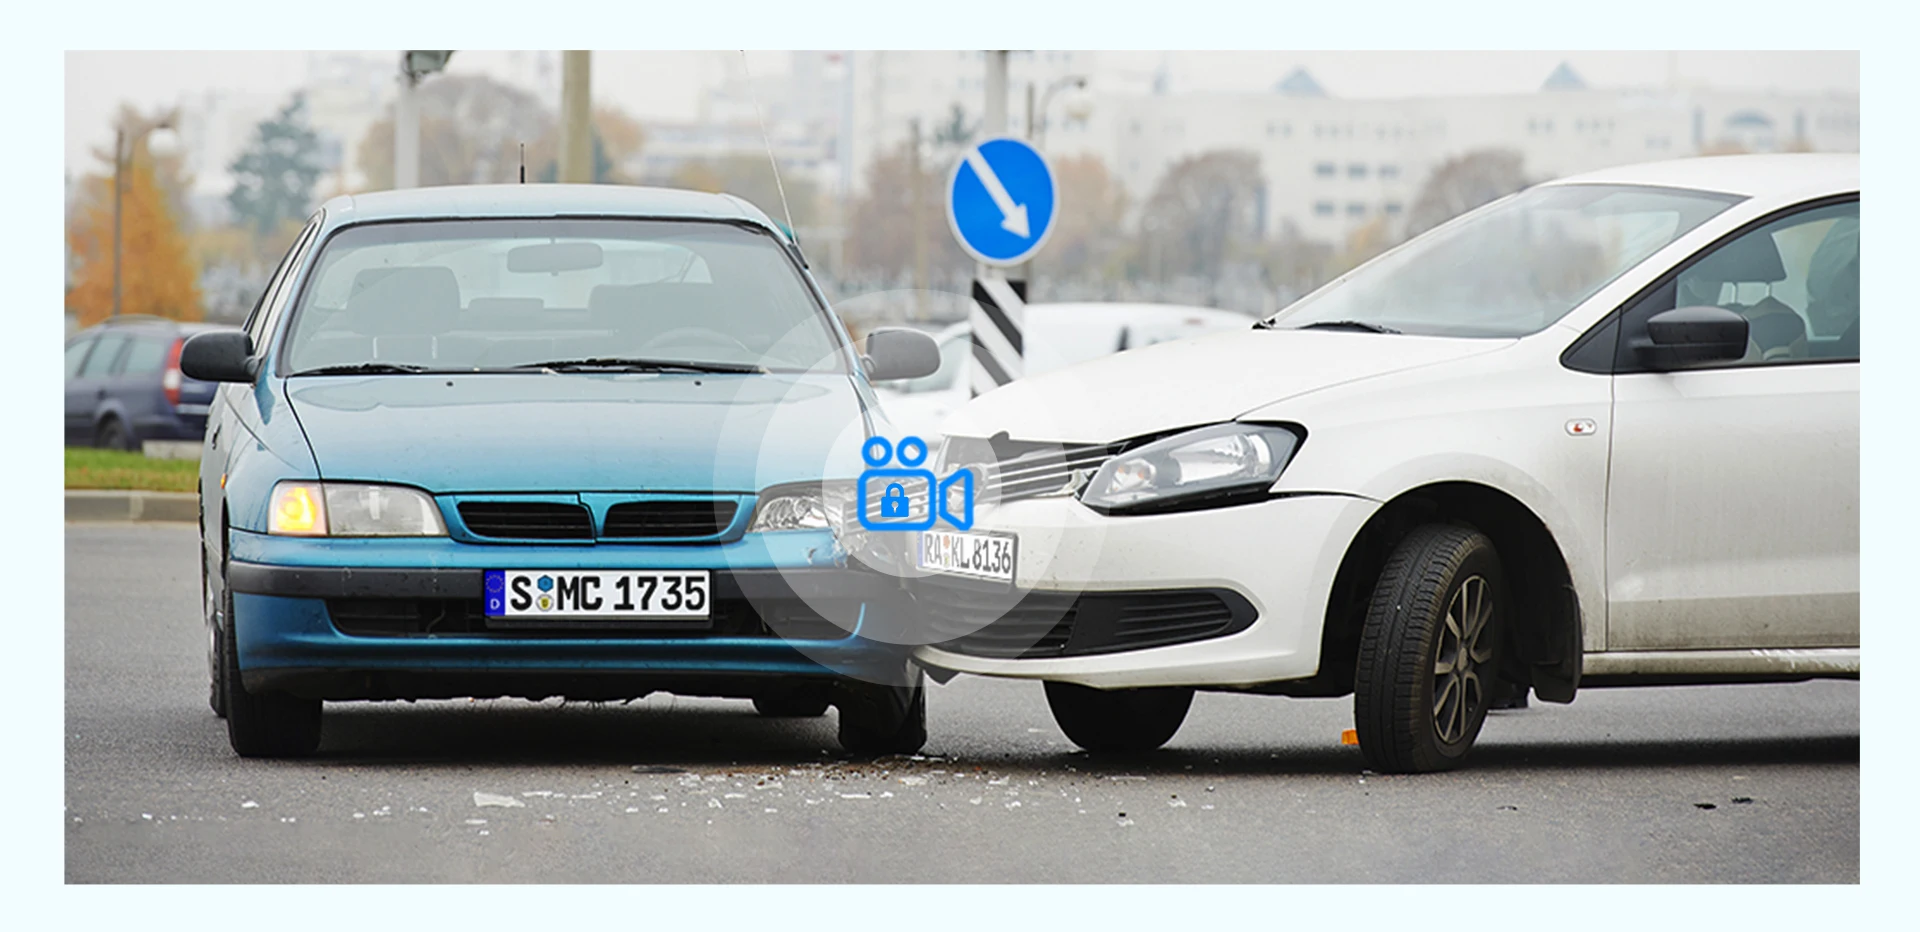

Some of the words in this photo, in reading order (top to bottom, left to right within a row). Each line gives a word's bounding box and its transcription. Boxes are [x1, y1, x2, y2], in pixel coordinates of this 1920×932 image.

[924, 533, 942, 565] RA
[951, 535, 970, 569] KL
[972, 538, 1011, 574] 8136
[490, 598, 500, 610] D
[510, 575, 533, 611] S
[557, 576, 603, 611] MC
[613, 576, 706, 611] 1735
